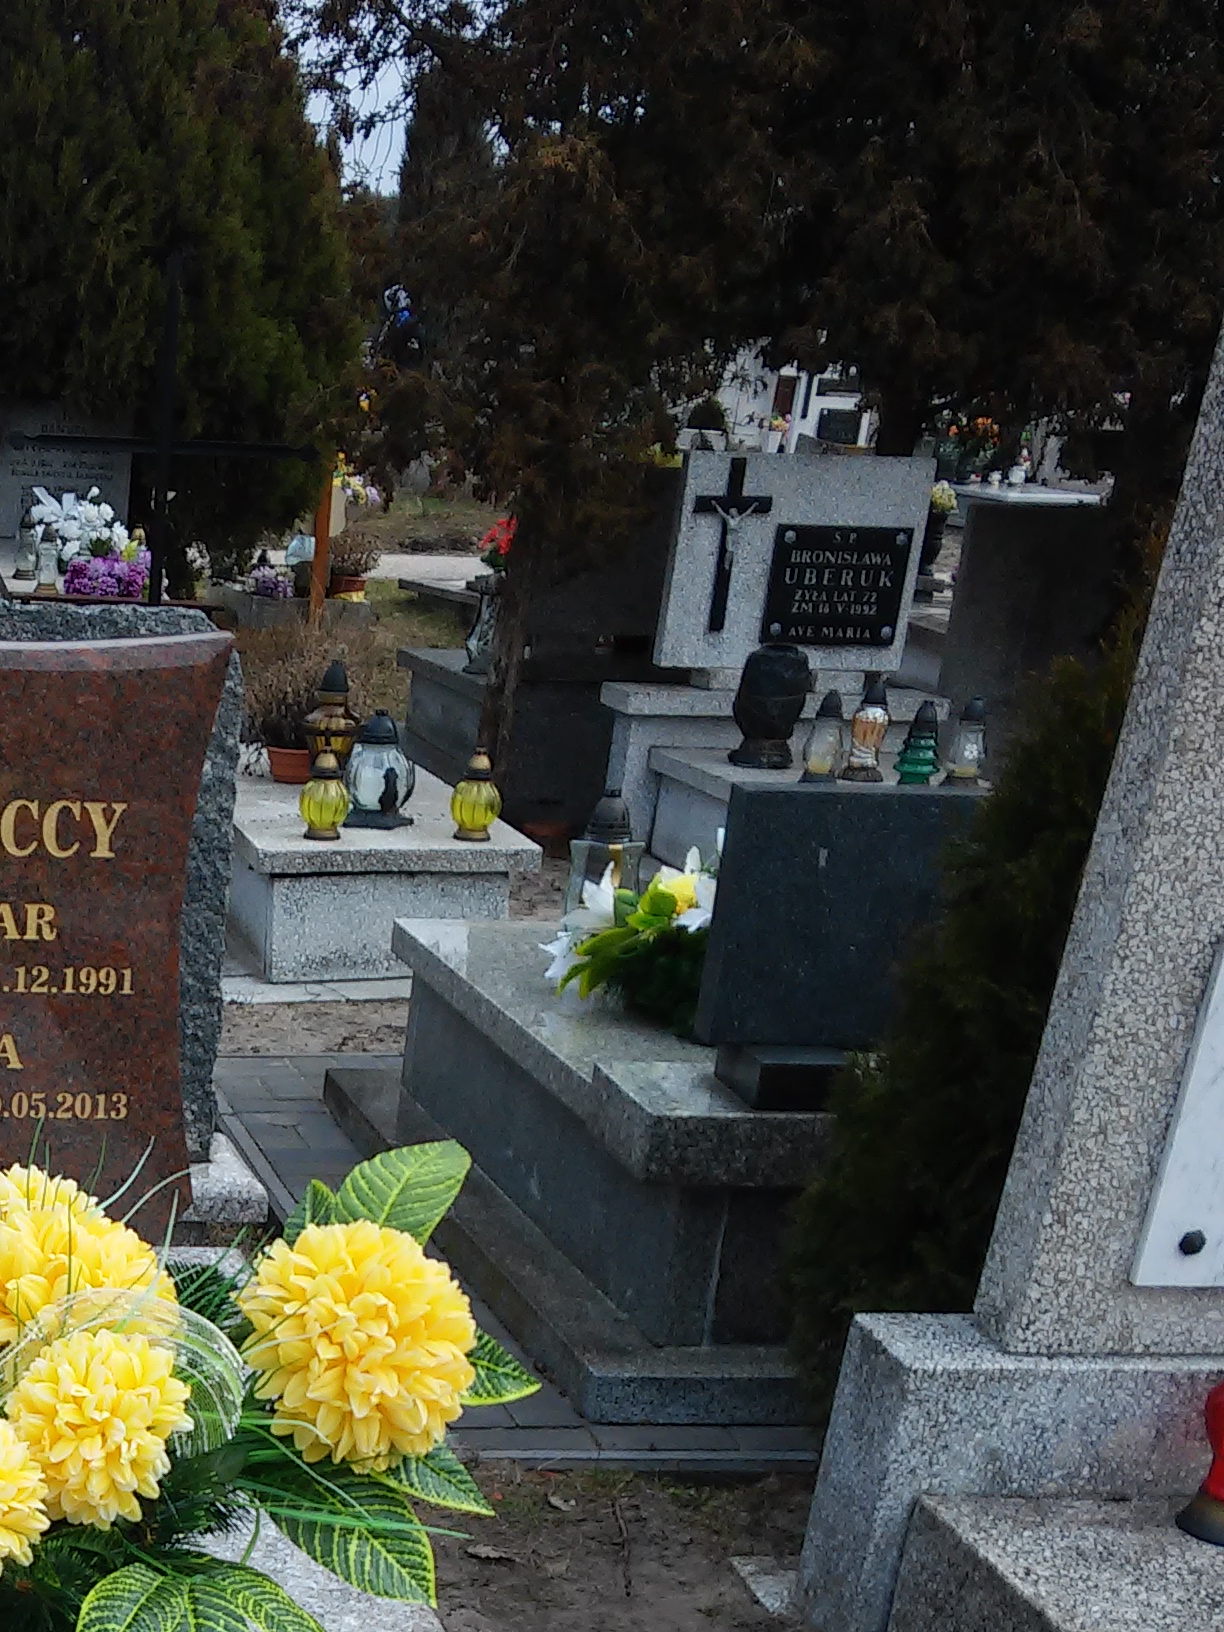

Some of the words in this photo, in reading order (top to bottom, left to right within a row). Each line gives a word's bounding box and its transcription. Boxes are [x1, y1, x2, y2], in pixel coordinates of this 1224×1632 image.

[790, 549, 892, 566] BRONISŁAWA
[784, 567, 894, 587] UBERUK
[833, 590, 857, 602] LAT
[788, 626, 815, 638] AVE
[821, 626, 871, 639] MARIA
